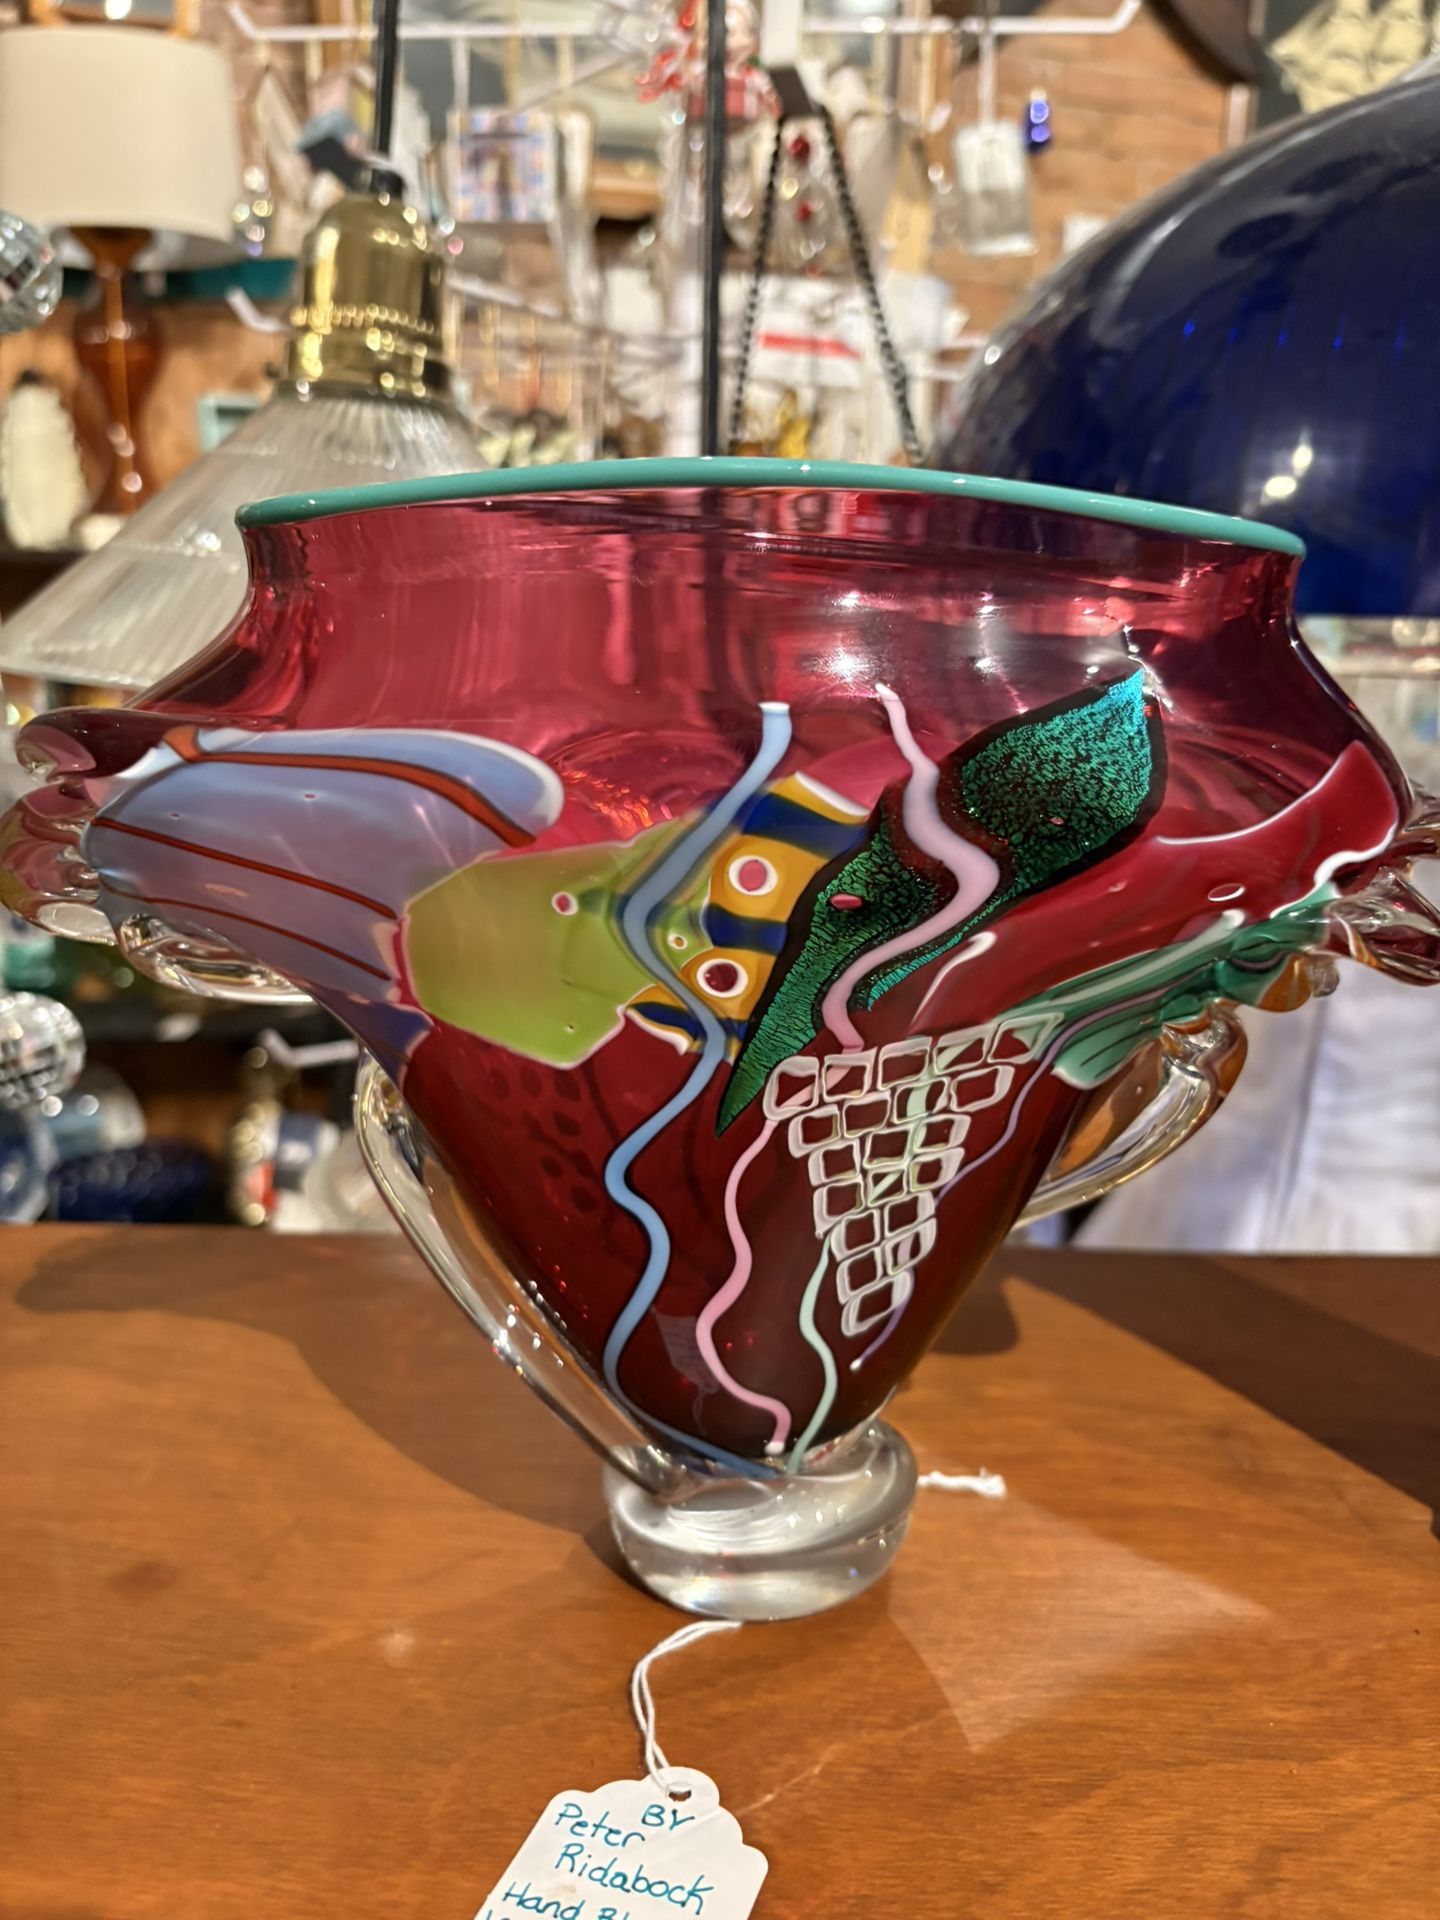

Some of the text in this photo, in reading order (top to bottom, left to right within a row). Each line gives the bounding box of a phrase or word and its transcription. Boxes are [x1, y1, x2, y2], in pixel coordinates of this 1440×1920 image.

[555, 1803, 645, 1848] Peter
[502, 1881, 586, 1920] Hand
[555, 1843, 714, 1915] Ridabock
